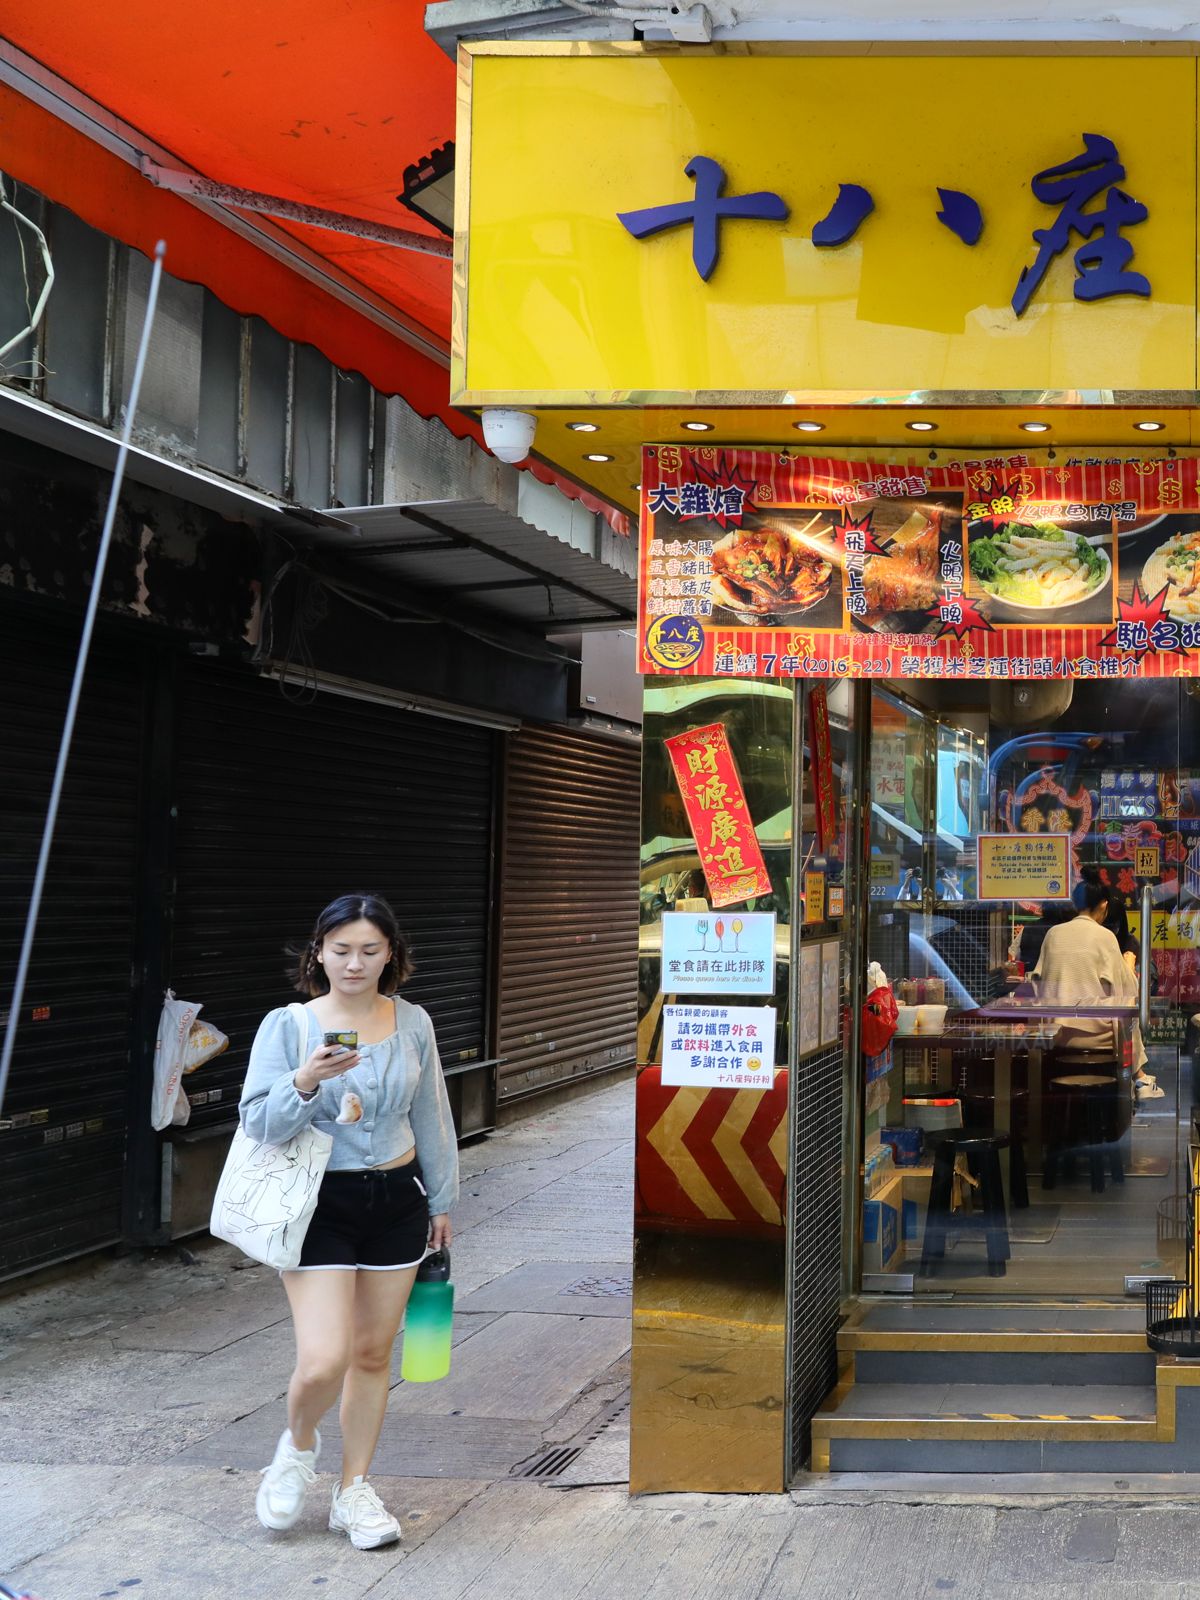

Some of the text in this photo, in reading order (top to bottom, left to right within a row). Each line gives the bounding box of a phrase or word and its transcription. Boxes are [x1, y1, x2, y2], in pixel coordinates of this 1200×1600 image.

[833, 476, 928, 505] 限量發售
[646, 482, 746, 516] 大雜燴
[648, 540, 714, 556] 原味大腸
[648, 561, 714, 576] 五香豬肚
[648, 579, 714, 596] 清湯豬皮
[651, 624, 702, 645] 十八座
[901, 655, 1141, 677] 榮獲米芝蓮街頭小食推介
[685, 744, 757, 878] 財源廣進
[992, 843, 1056, 853] 十八座狗仔粉
[1140, 852, 1153, 868] 拉
[668, 959, 766, 973] 堂食請在此排隊
[666, 1008, 728, 1018] 各位親愛的顧客
[678, 1022, 758, 1037] 請勿攜帶外食
[671, 1038, 763, 1053] 或飲料進入食用
[690, 1055, 743, 1069] 多謝合作
[717, 1074, 770, 1084] 十八座狗仔粉
